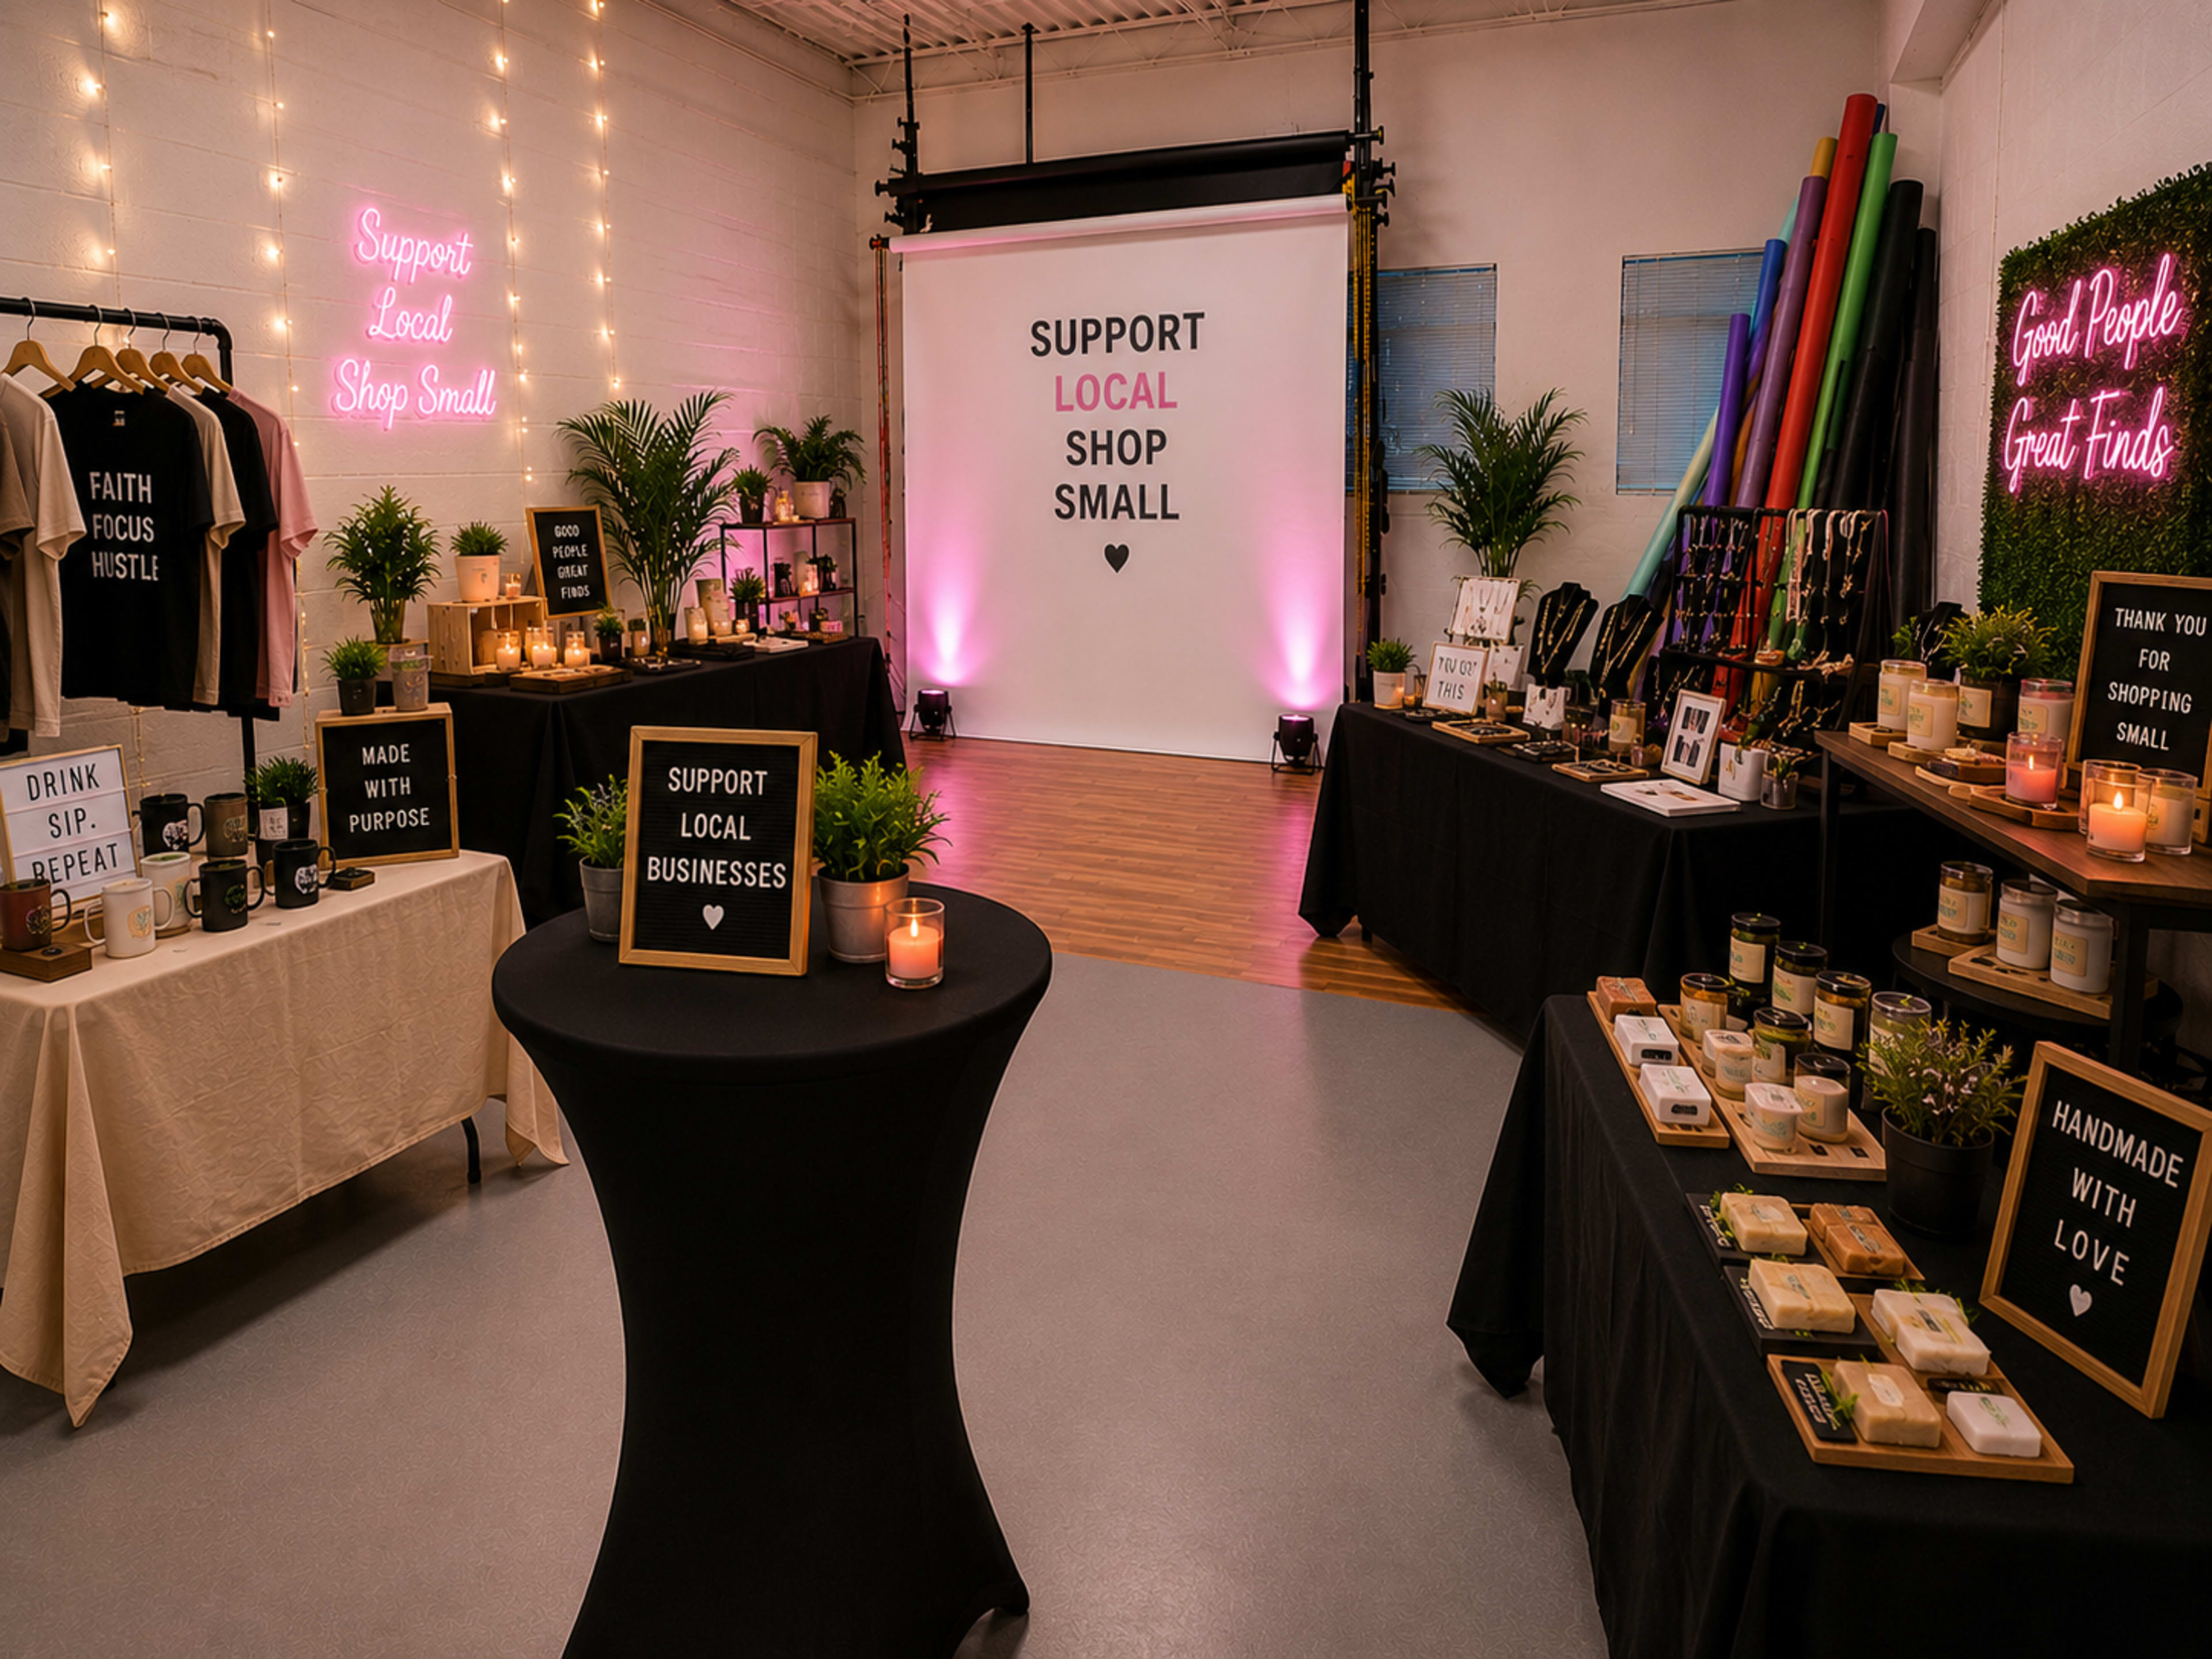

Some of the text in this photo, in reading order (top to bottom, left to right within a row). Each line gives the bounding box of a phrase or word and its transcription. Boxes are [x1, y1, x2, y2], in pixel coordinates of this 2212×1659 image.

[358, 208, 474, 283] Support
[370, 287, 452, 341] Local
[2014, 254, 2181, 386] Good People
[1031, 312, 1205, 357] SUPPORT
[336, 358, 495, 429] Shop Small
[1056, 372, 1177, 411] LOCAL
[1067, 430, 1166, 465] SHOP
[2005, 387, 2173, 492] Great Finds
[90, 472, 151, 503] FAITH
[1055, 484, 1179, 520] SMALL
[93, 515, 154, 542] FOCUS
[93, 552, 158, 581] HUSTLE
[2116, 608, 2206, 636] THANK YOU
[2139, 649, 2169, 671] FOR
[1438, 681, 1464, 699] THIS
[2108, 682, 2191, 713] SHOPPING
[2117, 722, 2168, 750] SMALL
[363, 744, 410, 764] MADE
[26, 763, 100, 801] DRINK
[365, 777, 410, 798] WITH
[669, 767, 767, 794] SUPPORT
[49, 808, 95, 838] SIP.
[350, 808, 429, 832] PURPOSE
[681, 813, 751, 840] LOCAL
[32, 843, 118, 883] REPEAT
[648, 857, 785, 888] BUSINESSES
[2052, 1099, 2184, 1188] HANDMADE
[2071, 1166, 2137, 1228] WITH
[2054, 1219, 2131, 1286] LOVE
